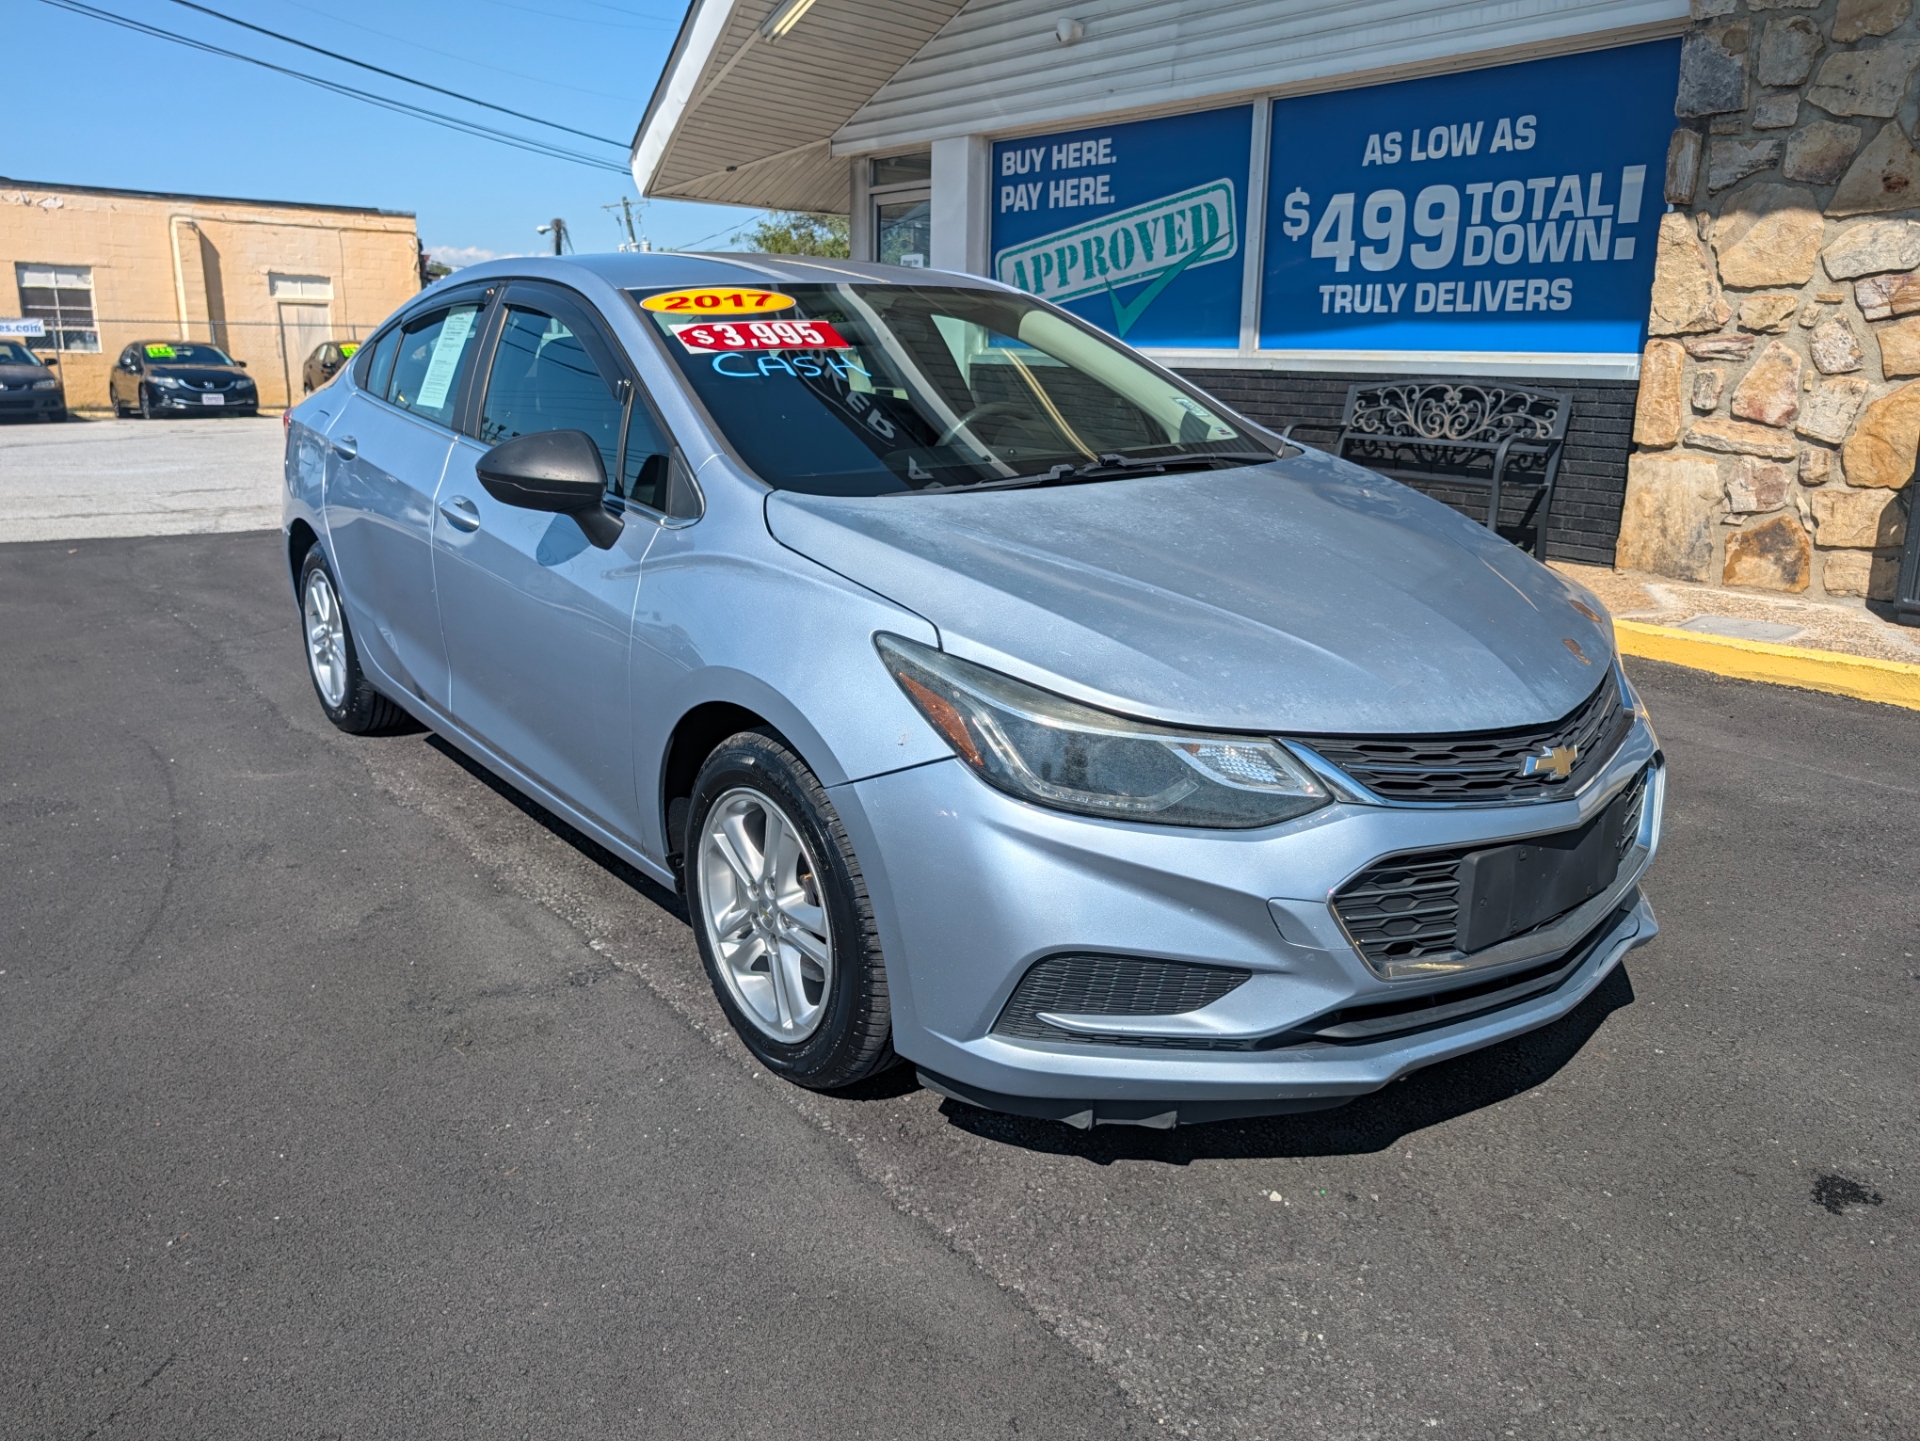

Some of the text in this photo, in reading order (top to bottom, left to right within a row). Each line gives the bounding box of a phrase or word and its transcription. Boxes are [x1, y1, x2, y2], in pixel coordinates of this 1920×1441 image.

[1001, 138, 1117, 176] BUY HERE.
[1362, 115, 1537, 166] AS LOW AS
[1001, 175, 1115, 213] PAY HERE.
[1465, 172, 1614, 225] TOTAL
[1012, 202, 1219, 294] APPROVED
[1283, 186, 1461, 272] $499
[664, 293, 772, 310] 2017
[1319, 278, 1573, 313] TRULY DELIVERS
[691, 323, 825, 347] $3,995
[711, 352, 872, 378] CASH
